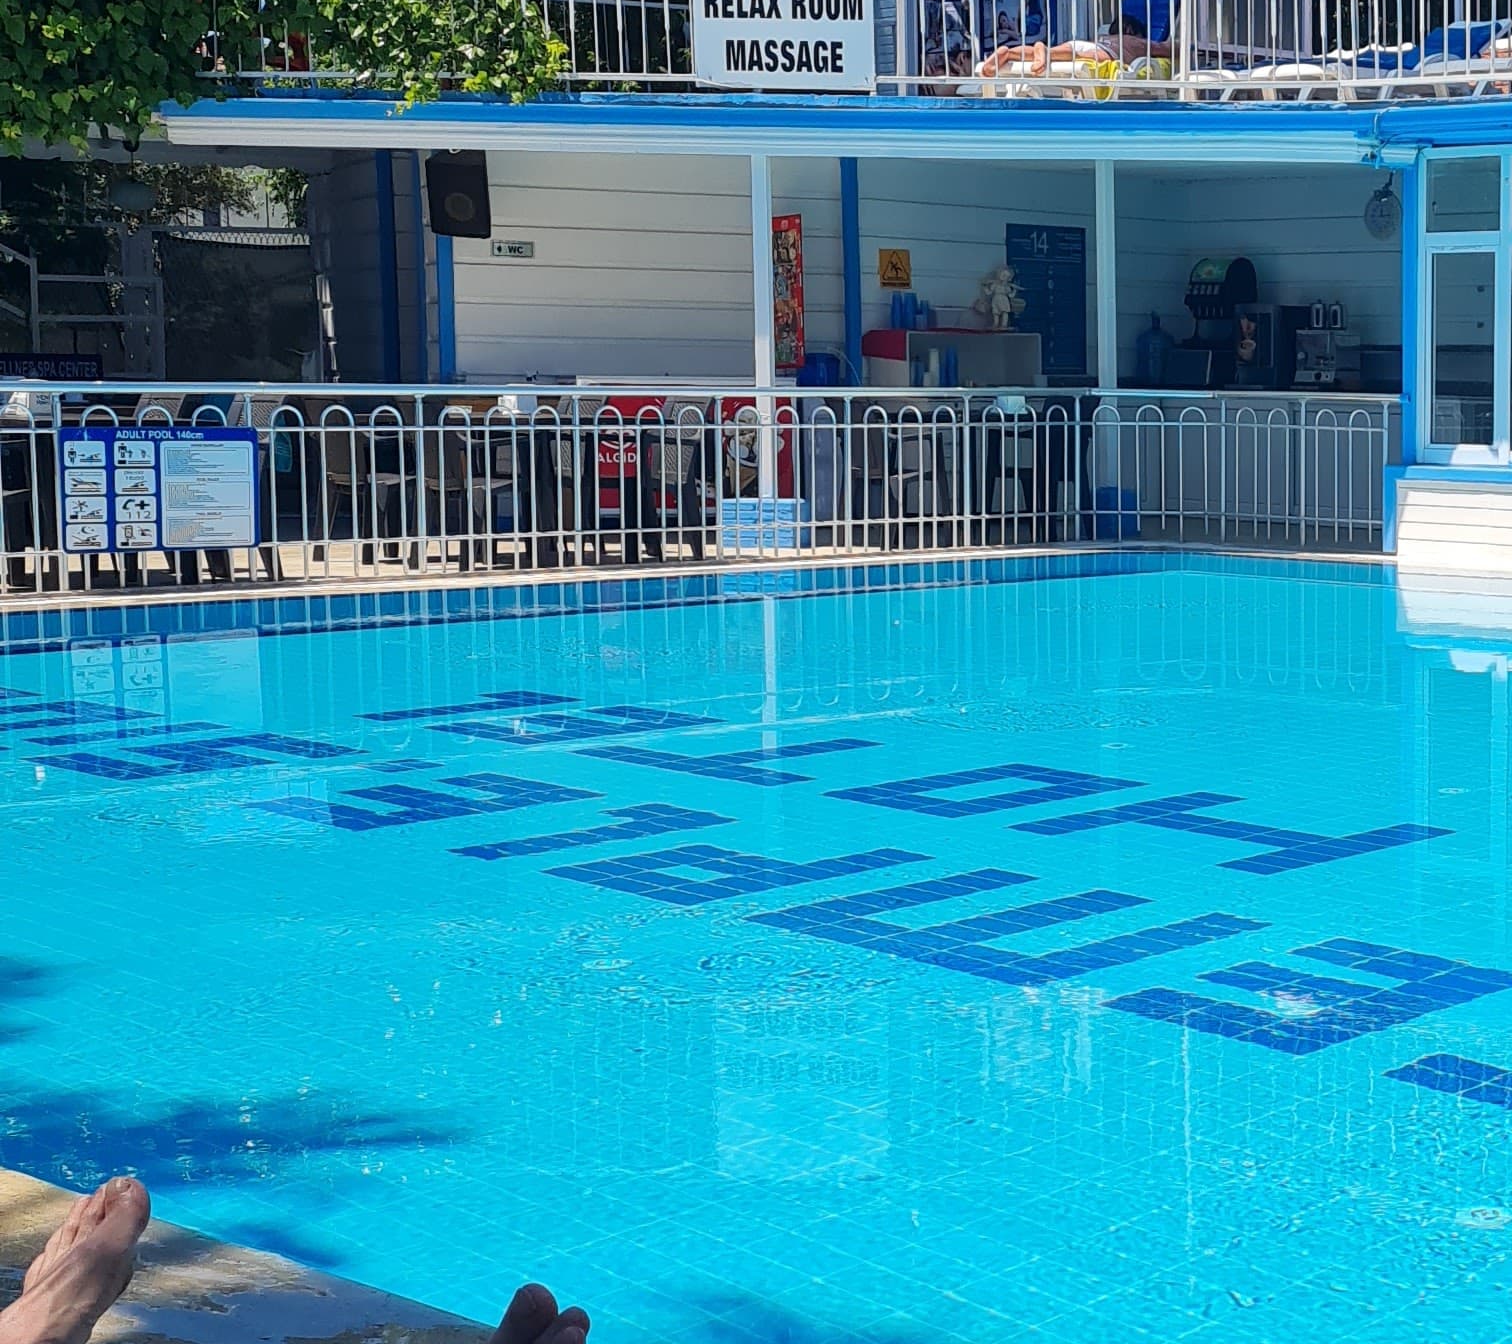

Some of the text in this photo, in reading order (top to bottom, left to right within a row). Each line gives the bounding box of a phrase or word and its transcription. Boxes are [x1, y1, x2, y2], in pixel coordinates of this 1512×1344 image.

[725, 39, 844, 73] MASSAGE
[1030, 231, 1048, 254] 14
[507, 245, 524, 254] WC
[58, 361, 98, 378] CENTER
[116, 430, 204, 439] ADULT POOL 140cm
[598, 453, 637, 463] ALGID
